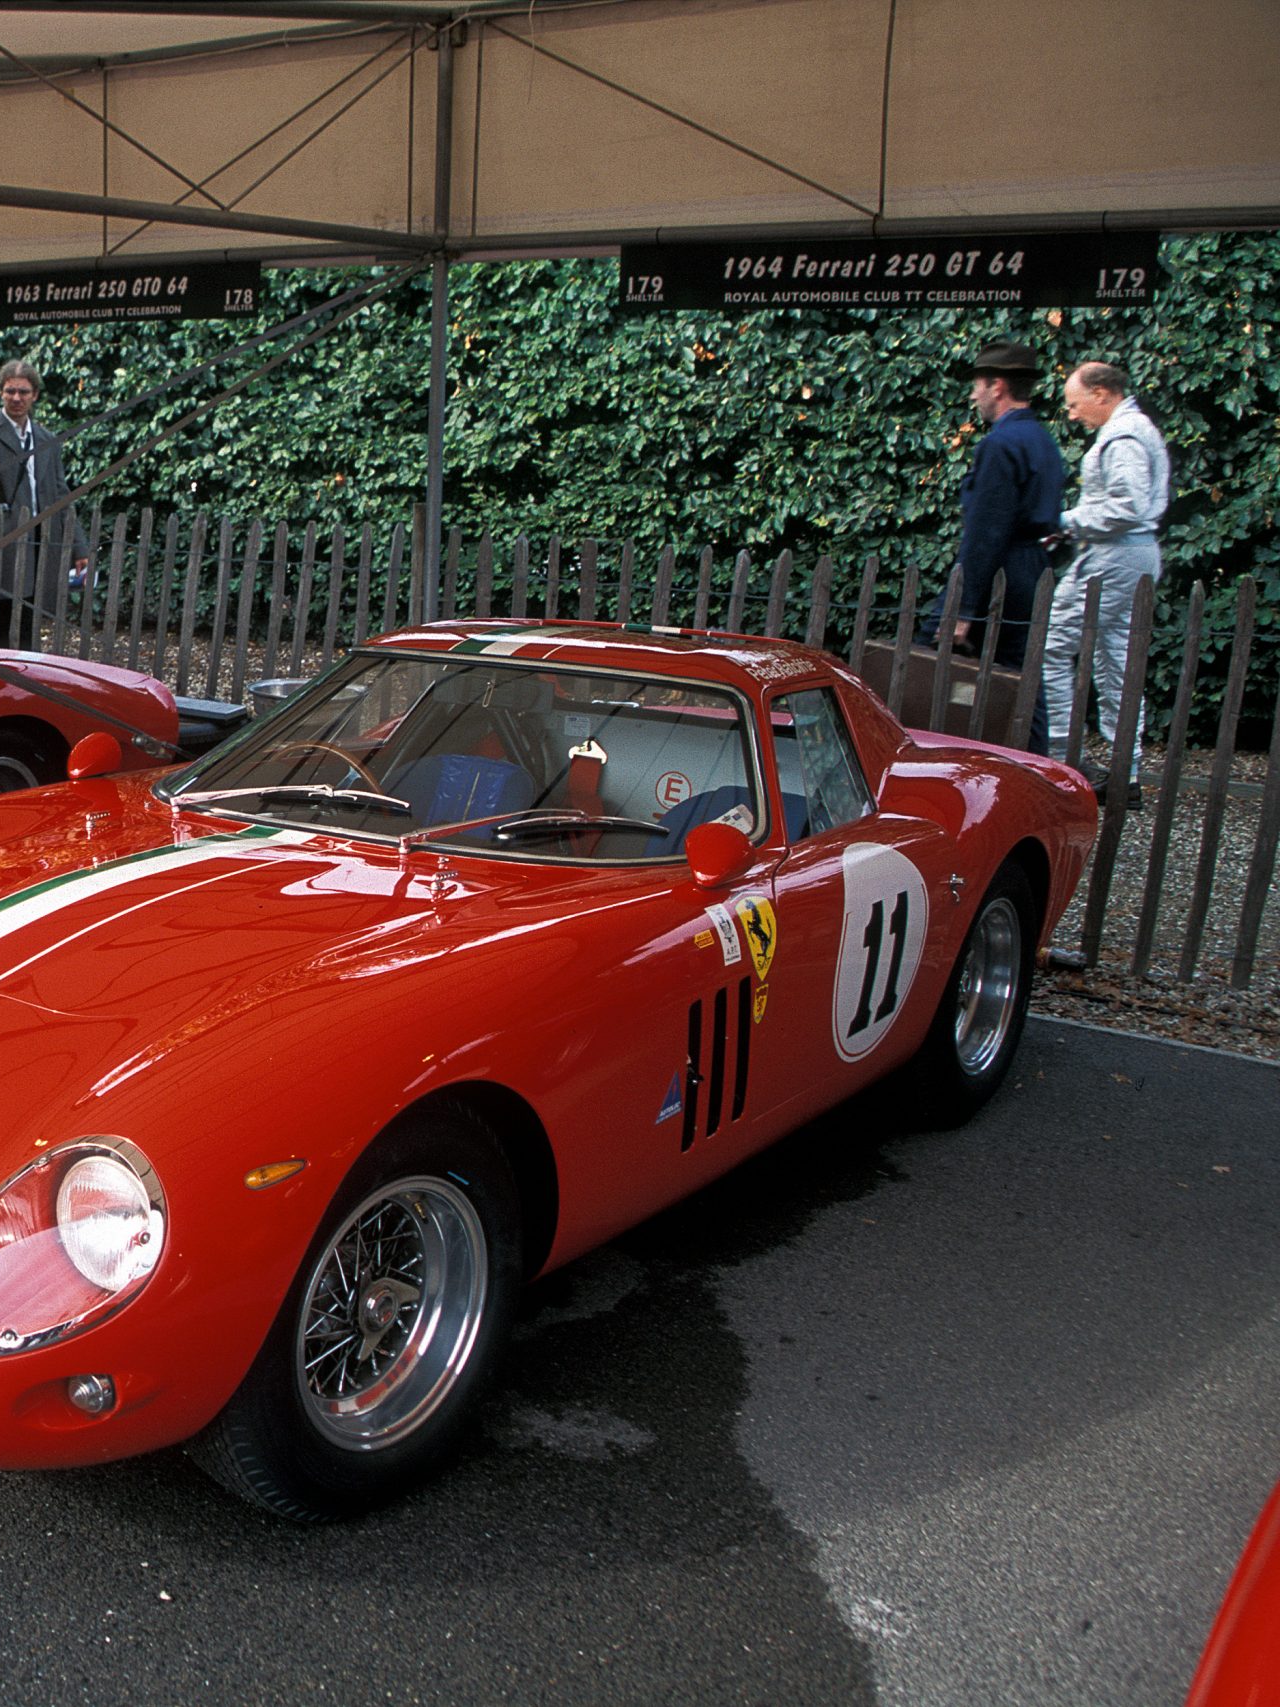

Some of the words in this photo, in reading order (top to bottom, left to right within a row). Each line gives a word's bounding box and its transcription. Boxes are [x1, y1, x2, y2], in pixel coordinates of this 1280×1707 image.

[724, 256, 784, 279] 1964
[792, 253, 876, 278] Ferrari
[884, 253, 935, 276] 250
[945, 251, 981, 276] GT
[988, 251, 1024, 275] 64
[628, 276, 664, 294] 179
[1099, 268, 1146, 290] 179
[6, 285, 41, 303] 1963
[46, 281, 93, 302] Ferrari
[98, 280, 127, 298] 250
[132, 277, 162, 297] GTO
[167, 276, 189, 295] 64
[225, 289, 253, 305] 178
[625, 293, 664, 302] SHELTER
[724, 292, 768, 303] ROYAL
[771, 291, 860, 302] AUTOMOBILE
[864, 290, 900, 302] CLUB
[904, 291, 922, 302] TT
[926, 289, 1021, 302] CELEBRATION
[1095, 288, 1146, 298] SHELTER
[13, 312, 39, 321] ROYAL
[41, 309, 90, 320] AUTOMOBILE
[91, 308, 112, 318] CLUB
[126, 305, 182, 316] CELEBRATION
[664, 777, 683, 803] E
[846, 890, 908, 1039] 11
